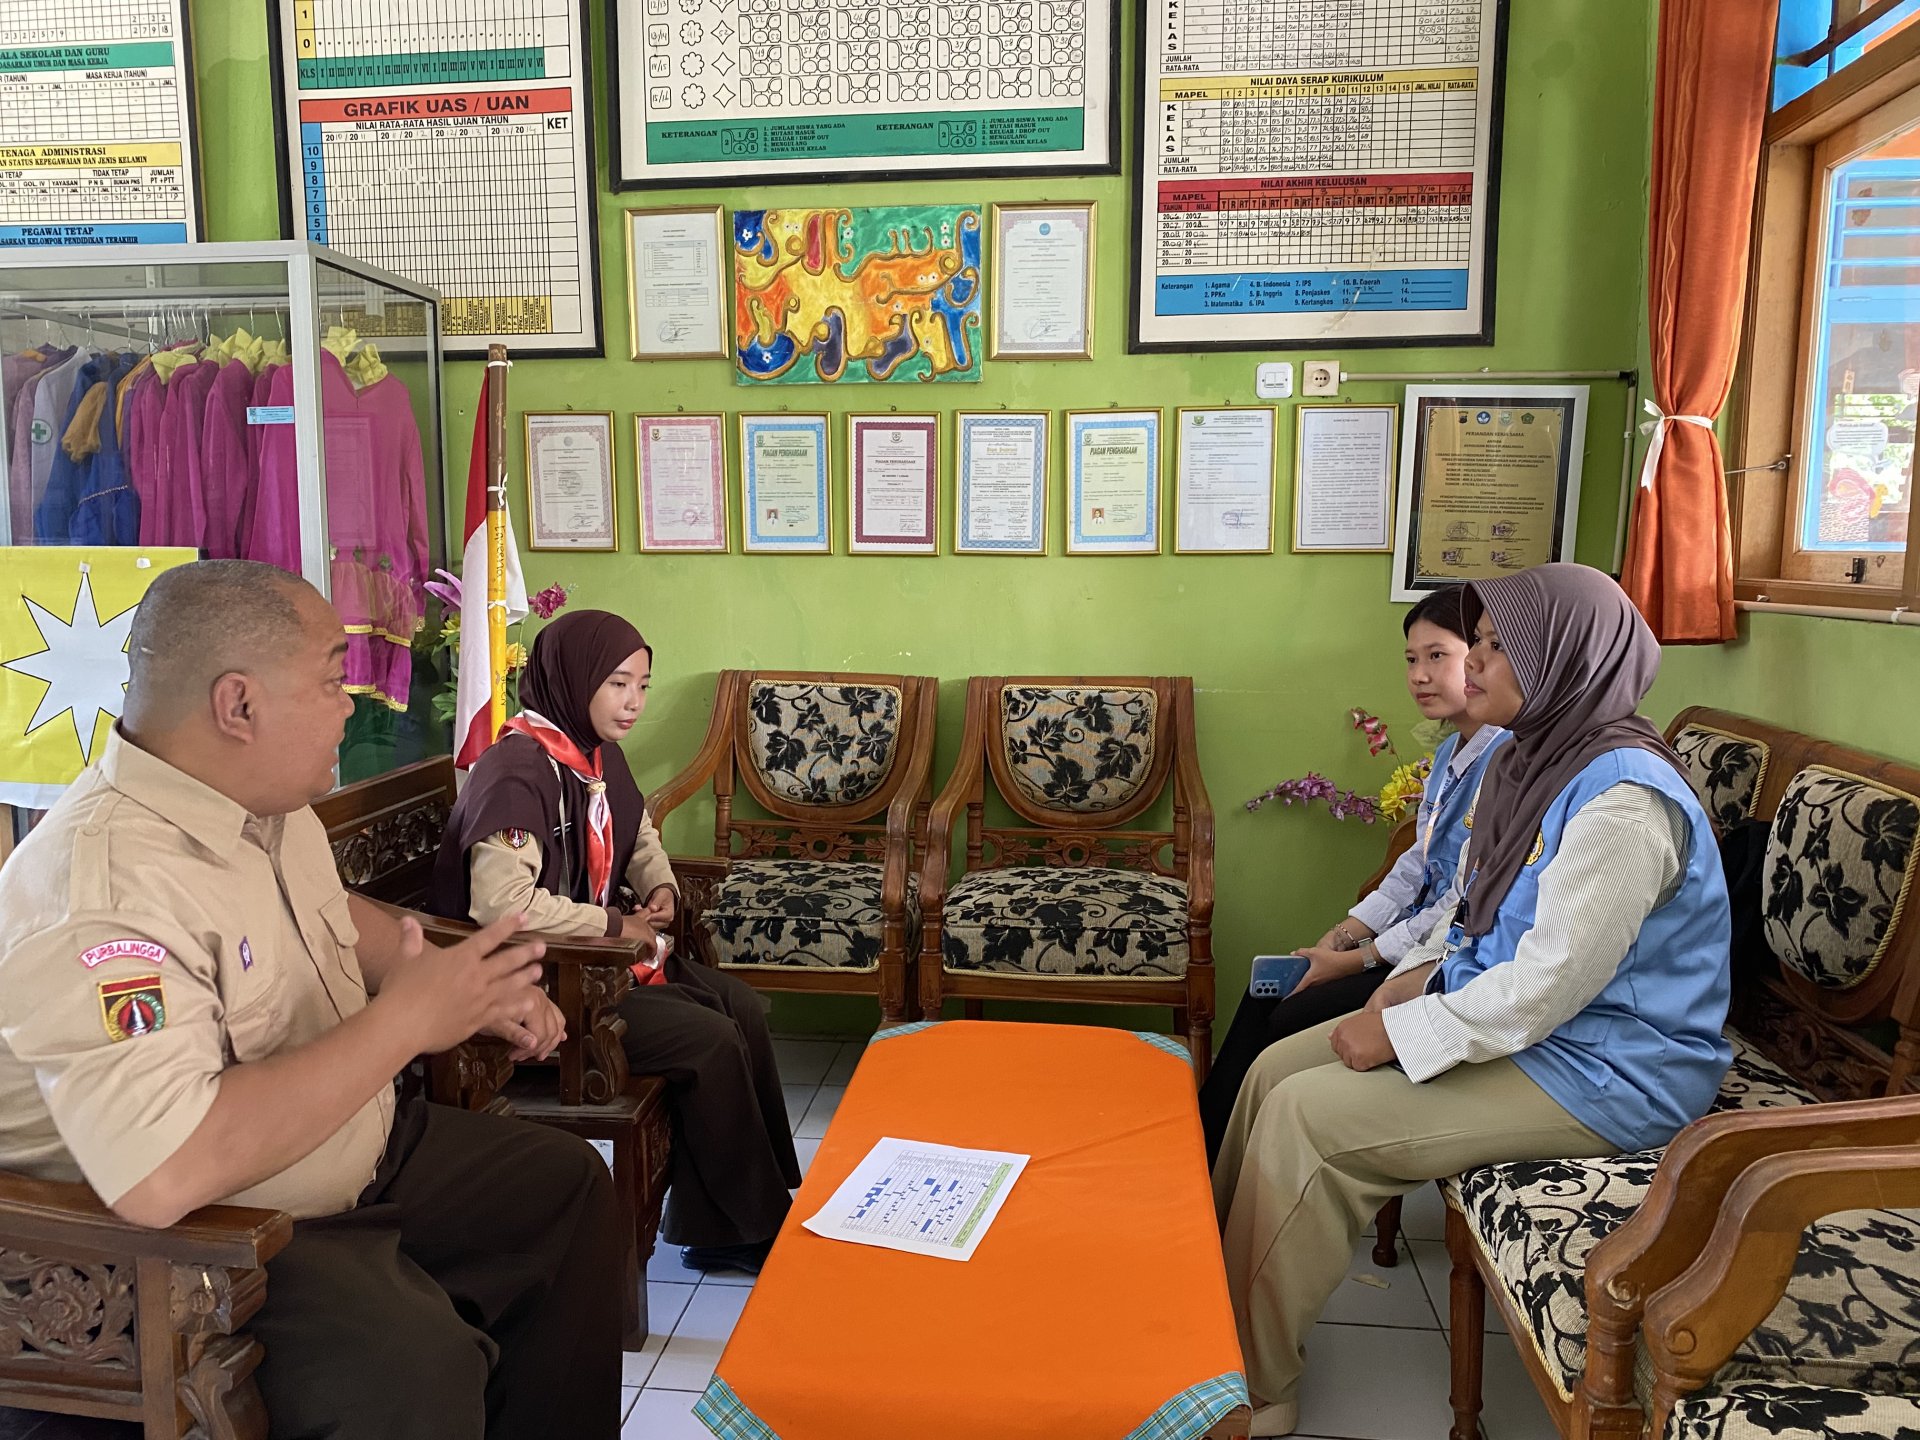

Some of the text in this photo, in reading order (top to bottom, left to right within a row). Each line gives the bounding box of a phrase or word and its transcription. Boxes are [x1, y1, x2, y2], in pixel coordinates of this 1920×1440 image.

[302, 10, 308, 18] 1
[303, 39, 310, 48] 0
[20, 50, 62, 58] SEKOLAH
[86, 48, 109, 56] GURU
[124, 69, 147, 78] (TAHUN)
[300, 68, 315, 78] KLS
[4, 74, 27, 83] (TAHUN)
[1301, 76, 1329, 84] SERAP
[1332, 74, 1384, 82] KURIKULUM
[344, 100, 420, 116] GRAFIK
[426, 98, 466, 112] UAS
[487, 96, 529, 110] UAN
[380, 120, 424, 129] RATA-RATA
[431, 118, 451, 126] HASIL
[454, 117, 477, 125] UJIAN
[481, 116, 509, 124] TAHUN
[547, 117, 568, 129] KET
[876, 122, 933, 130] KETERANGAN
[662, 130, 717, 138] KETERANGAN
[1, 148, 106, 157] TENAGA ADMINISTRASI
[306, 146, 319, 156] 10
[310, 161, 317, 170] 9
[312, 176, 318, 184] 8
[1315, 178, 1367, 186] KELULUSAN
[314, 204, 320, 214] 6
[314, 218, 320, 228] 5
[22, 227, 94, 236] PEGAWAI TETAP
[314, 232, 321, 242] 4
[1263, 290, 1282, 298] Inggris
